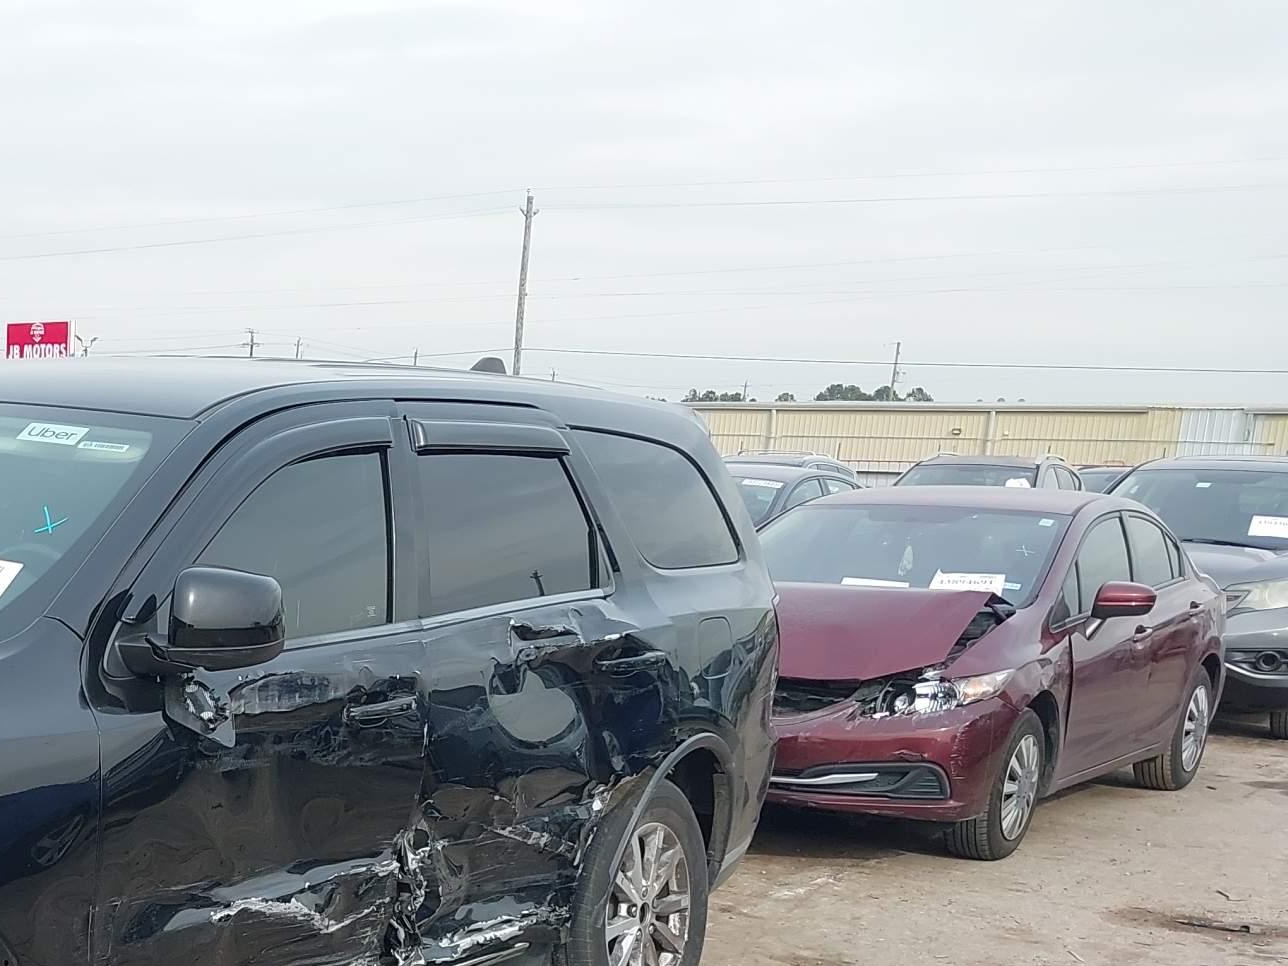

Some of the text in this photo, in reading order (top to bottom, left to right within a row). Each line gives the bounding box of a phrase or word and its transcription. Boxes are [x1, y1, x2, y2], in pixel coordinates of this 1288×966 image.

[8, 343, 66, 360] JB MOTORS
[27, 426, 78, 441] Uber
